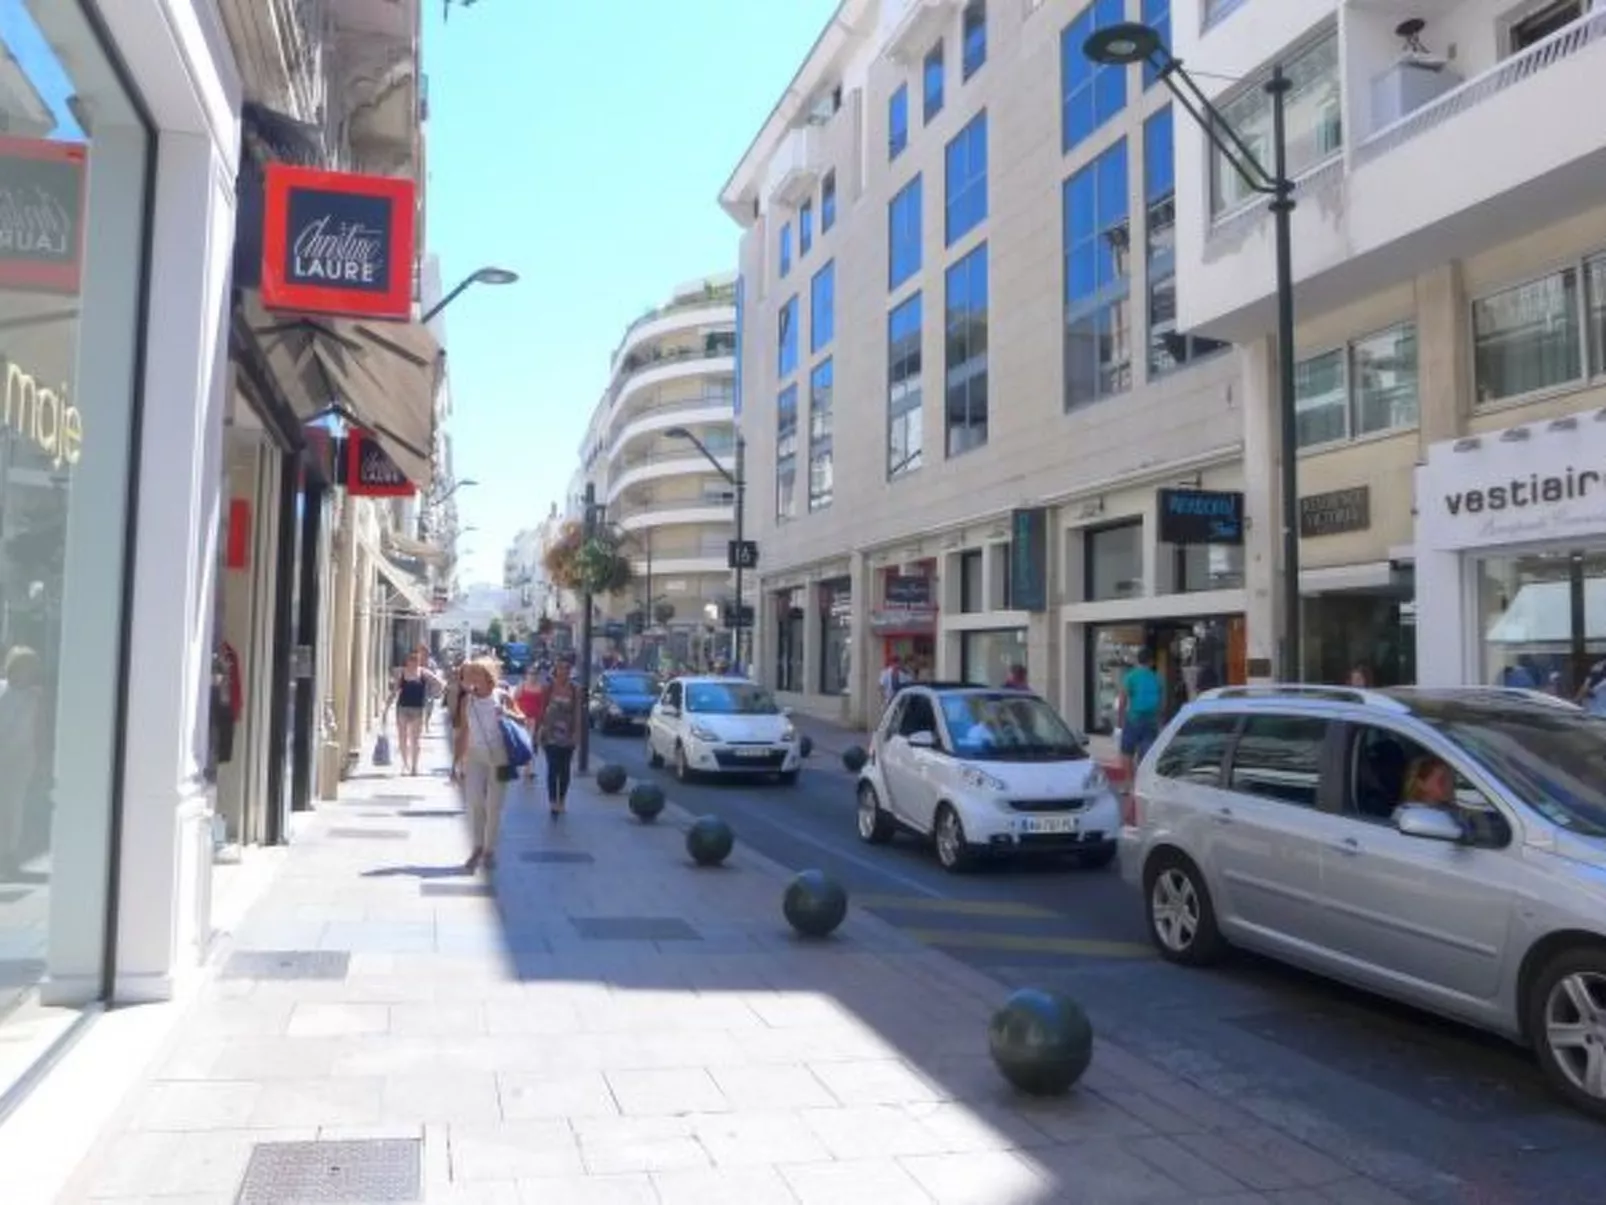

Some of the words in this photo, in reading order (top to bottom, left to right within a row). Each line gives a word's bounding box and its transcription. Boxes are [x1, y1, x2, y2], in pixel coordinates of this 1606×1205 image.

[293, 254, 375, 282] LAURE
[4, 362, 82, 472] maje
[1445, 465, 1606, 515] vestiair
